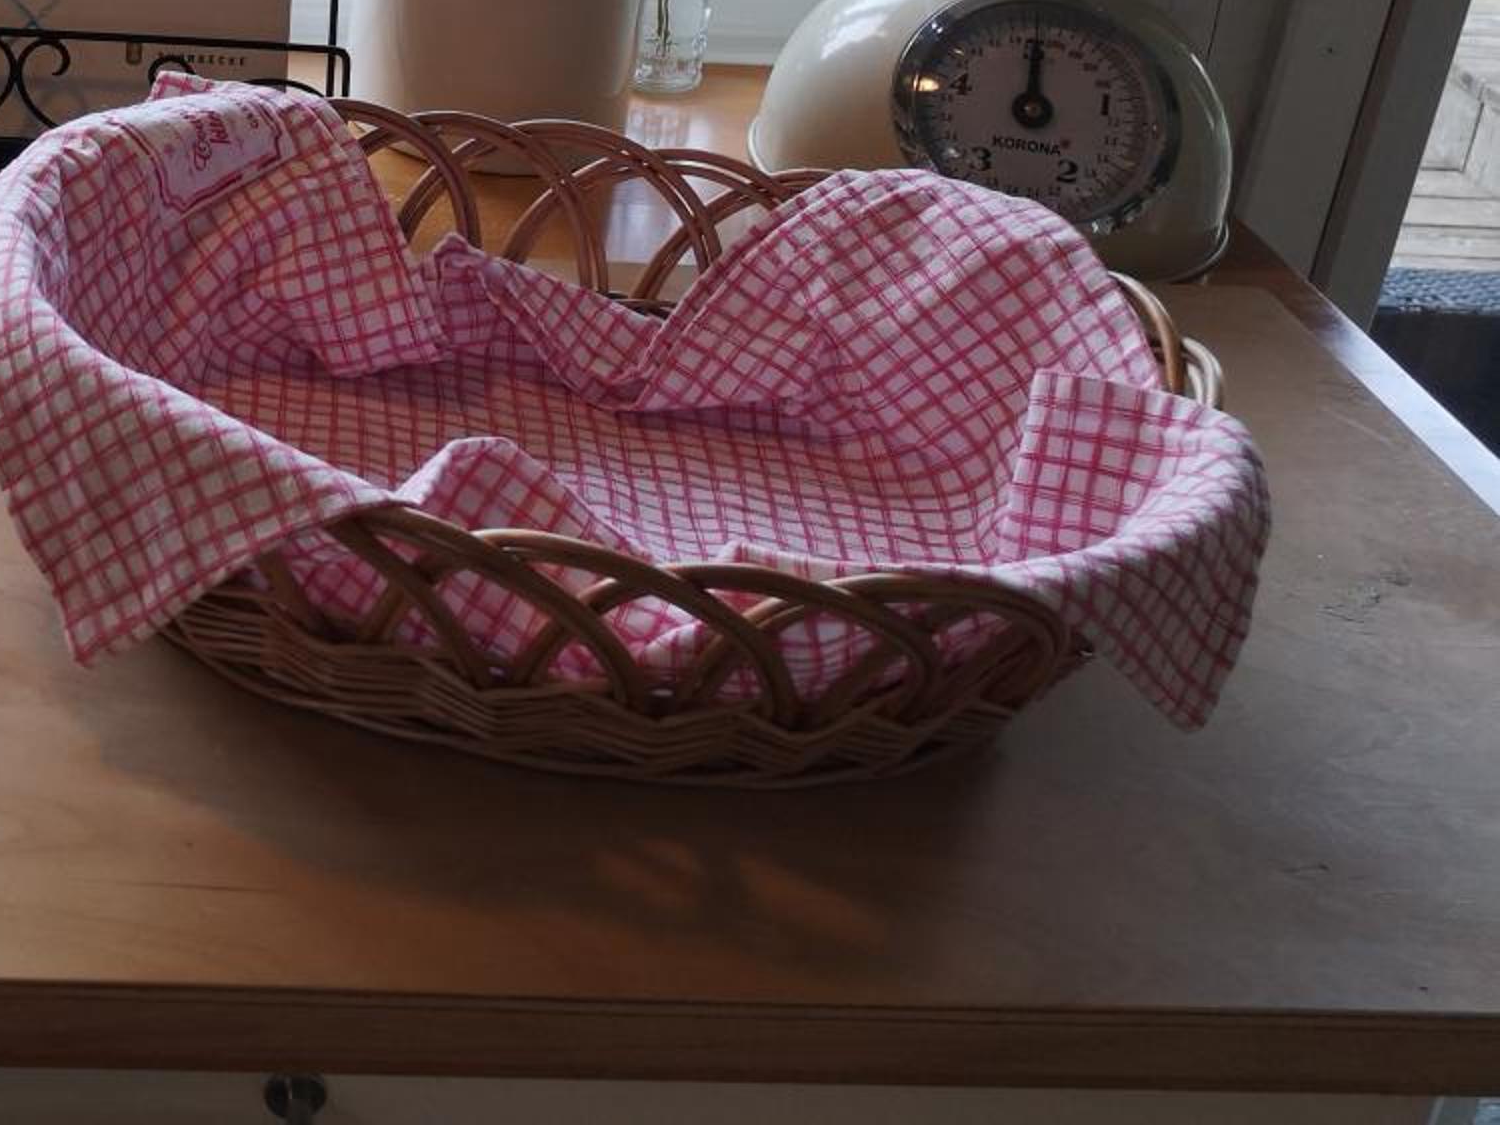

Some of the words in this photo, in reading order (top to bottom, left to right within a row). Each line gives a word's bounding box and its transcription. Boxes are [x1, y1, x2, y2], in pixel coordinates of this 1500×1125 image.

[950, 73, 972, 96] 4
[992, 135, 1061, 156] KORONA
[970, 147, 991, 172] 3
[1056, 160, 1078, 183] 2
